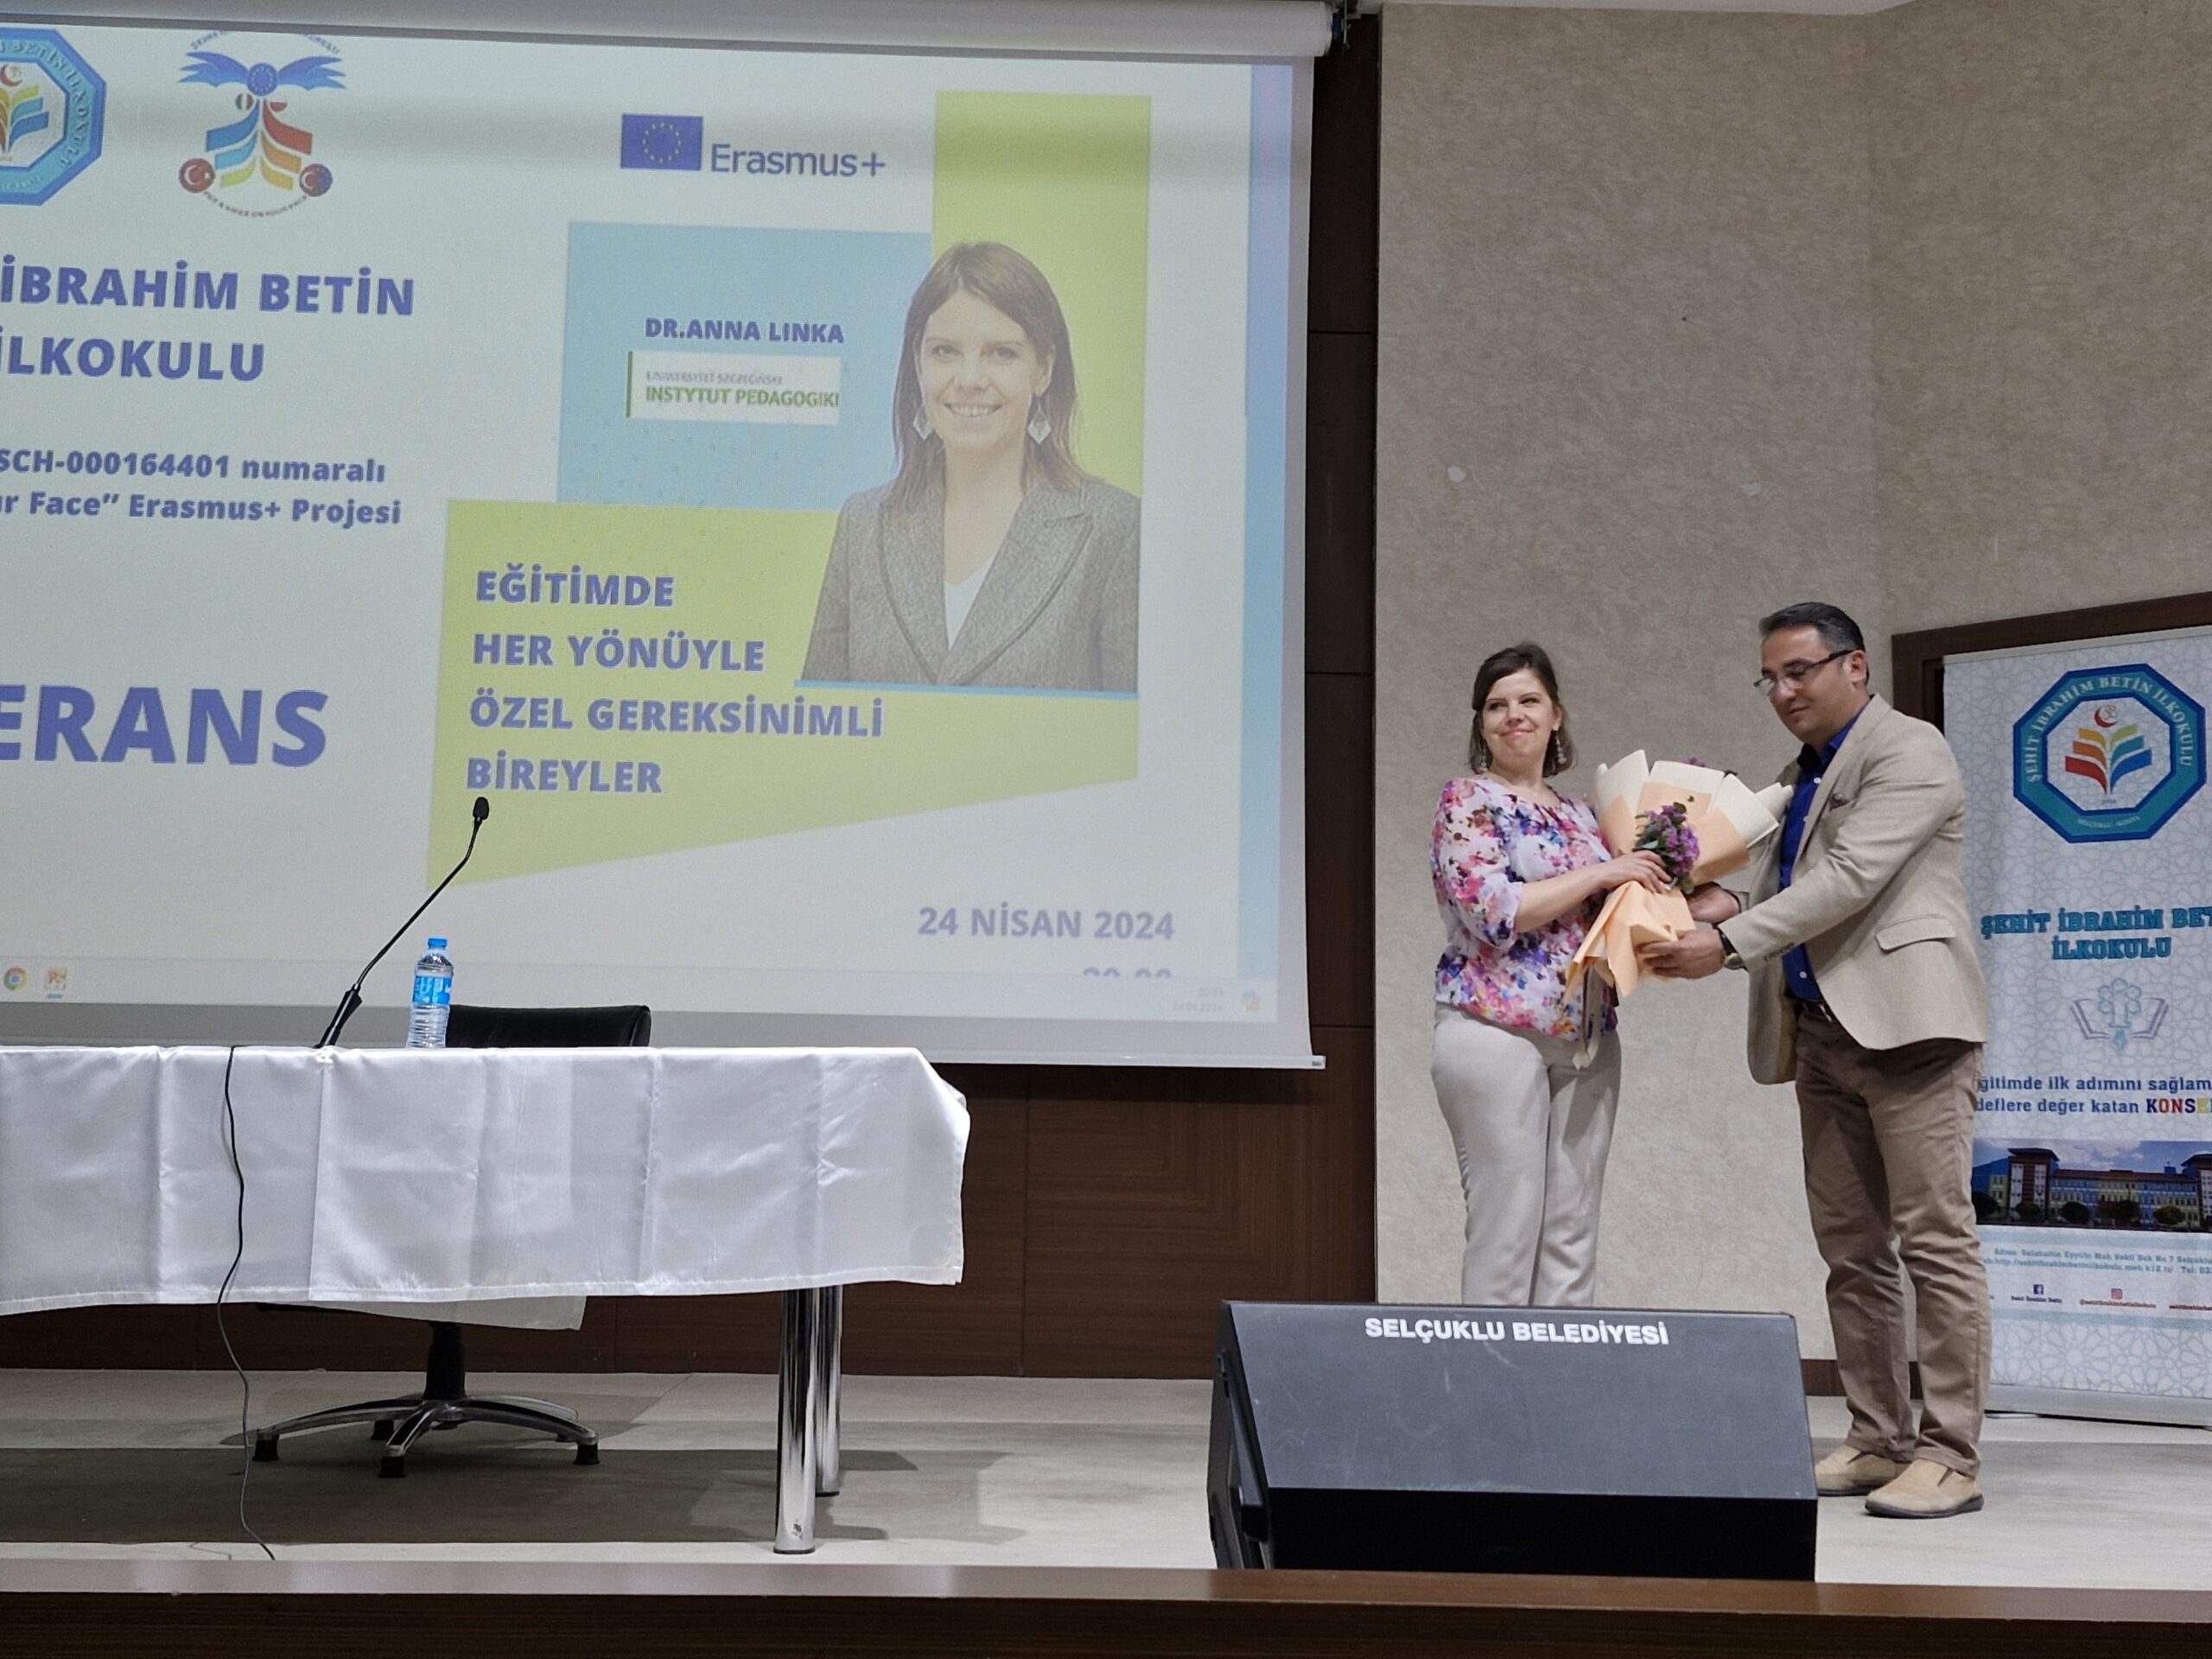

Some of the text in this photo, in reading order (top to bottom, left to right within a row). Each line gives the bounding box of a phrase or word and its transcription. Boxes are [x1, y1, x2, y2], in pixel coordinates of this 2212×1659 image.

[711, 143, 886, 176] Erasmus+
[0, 255, 414, 315] İBRAHİM BETİN
[645, 317, 844, 343] DR.ANNA LINKA
[646, 385, 839, 408] INSTYTUT PEDAGOGIKI
[0, 448, 385, 482] SCH-000164401 numaralı
[130, 493, 281, 520] Erasmus+
[292, 498, 401, 529] Projesi
[476, 562, 674, 607] EĞİTİMDE
[474, 629, 764, 671] HER YÖNÜYLE
[469, 688, 883, 737] ÖZEL GEREKSİNİMLİ
[467, 749, 663, 793] BİREYLER
[918, 901, 1174, 940] 24 NİSAN 2024
[1980, 909, 2051, 940] ŞEHİT
[2058, 905, 2164, 932] İBRAHİM
[2051, 935, 2172, 961] İLKOKULU
[2049, 1076, 2069, 1090] ilk
[2075, 1077, 2141, 1090] adımını
[2148, 1077, 2212, 1094] sağlam
[2037, 1098, 2084, 1115] değer
[2091, 1099, 2139, 1114] katan
[1365, 1318, 1669, 1345] SELÇUKLU BELEDİYESİ
